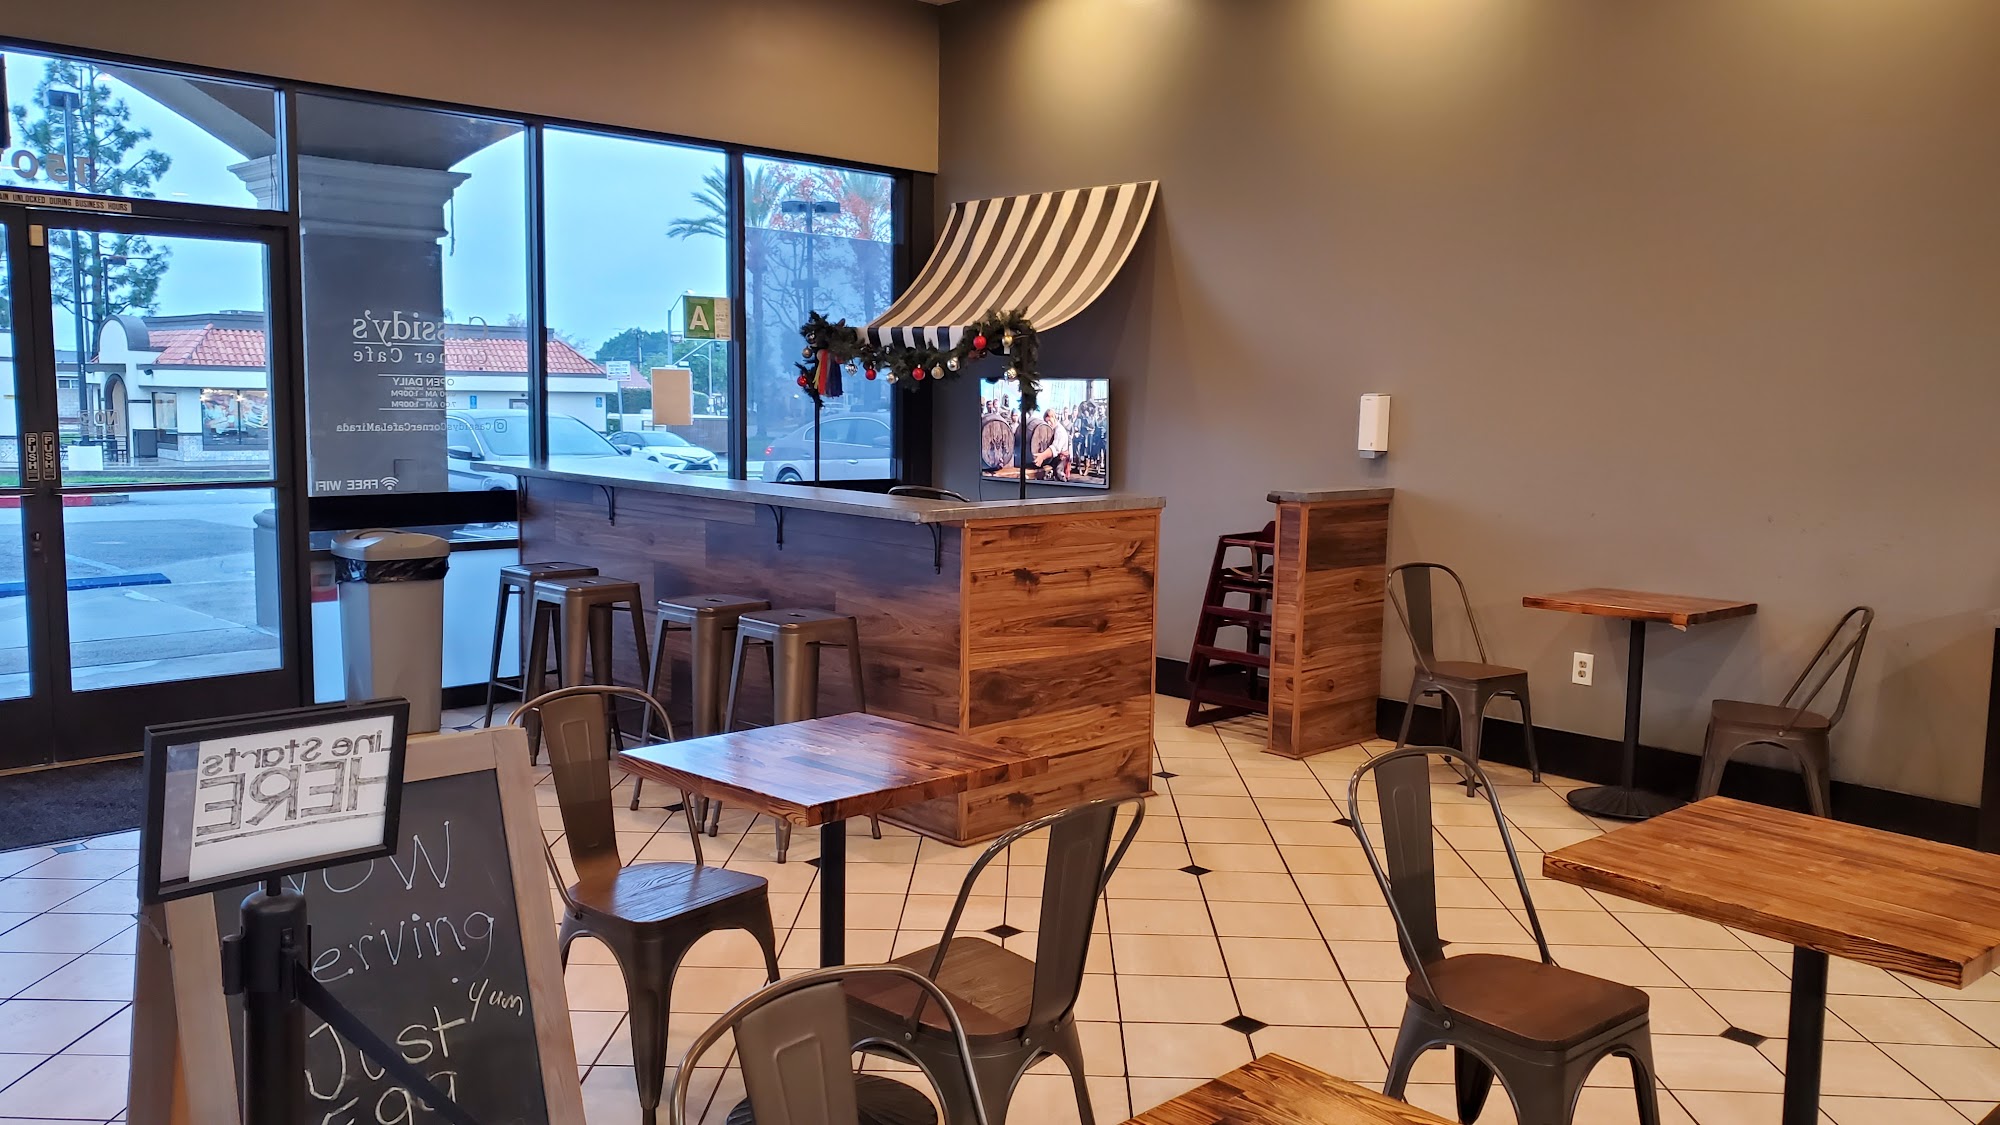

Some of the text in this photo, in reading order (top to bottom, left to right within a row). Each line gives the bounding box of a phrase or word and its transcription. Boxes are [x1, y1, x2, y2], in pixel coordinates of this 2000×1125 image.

[13, 193, 46, 204] UNLOCKED
[49, 197, 72, 206] DURING
[75, 200, 105, 210] BUSINESS
[107, 202, 128, 212] HOURS
[689, 305, 710, 331] A
[27, 437, 37, 470] PUSH
[44, 436, 54, 469] PUSH
[311, 911, 495, 983] erving
